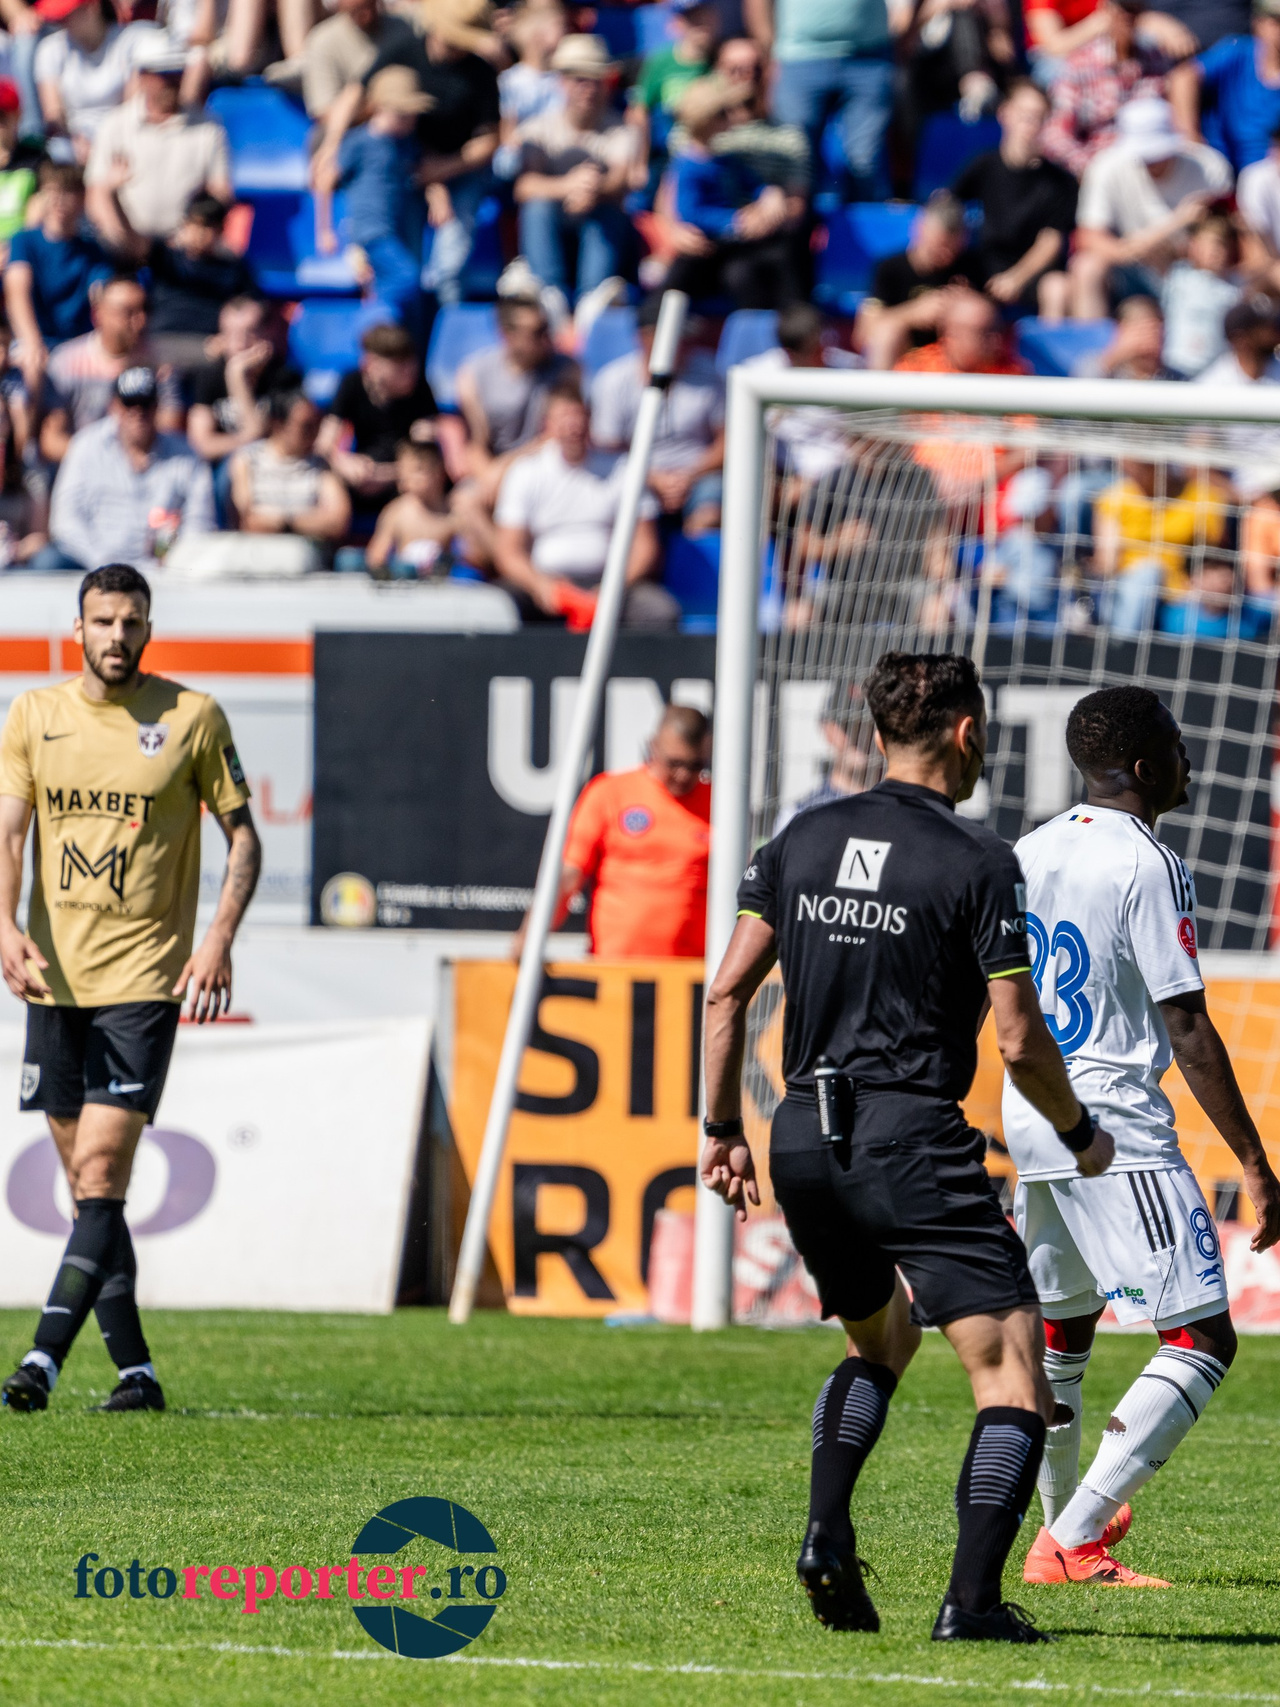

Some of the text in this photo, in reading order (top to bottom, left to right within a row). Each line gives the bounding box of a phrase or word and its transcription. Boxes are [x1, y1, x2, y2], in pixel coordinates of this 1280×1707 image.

[46, 786, 155, 822] MAXBET
[796, 894, 908, 935] NORDIS
[1000, 917, 1026, 936] NO
[828, 934, 866, 945] GROUP
[1123, 1286, 1144, 1297] Eco
